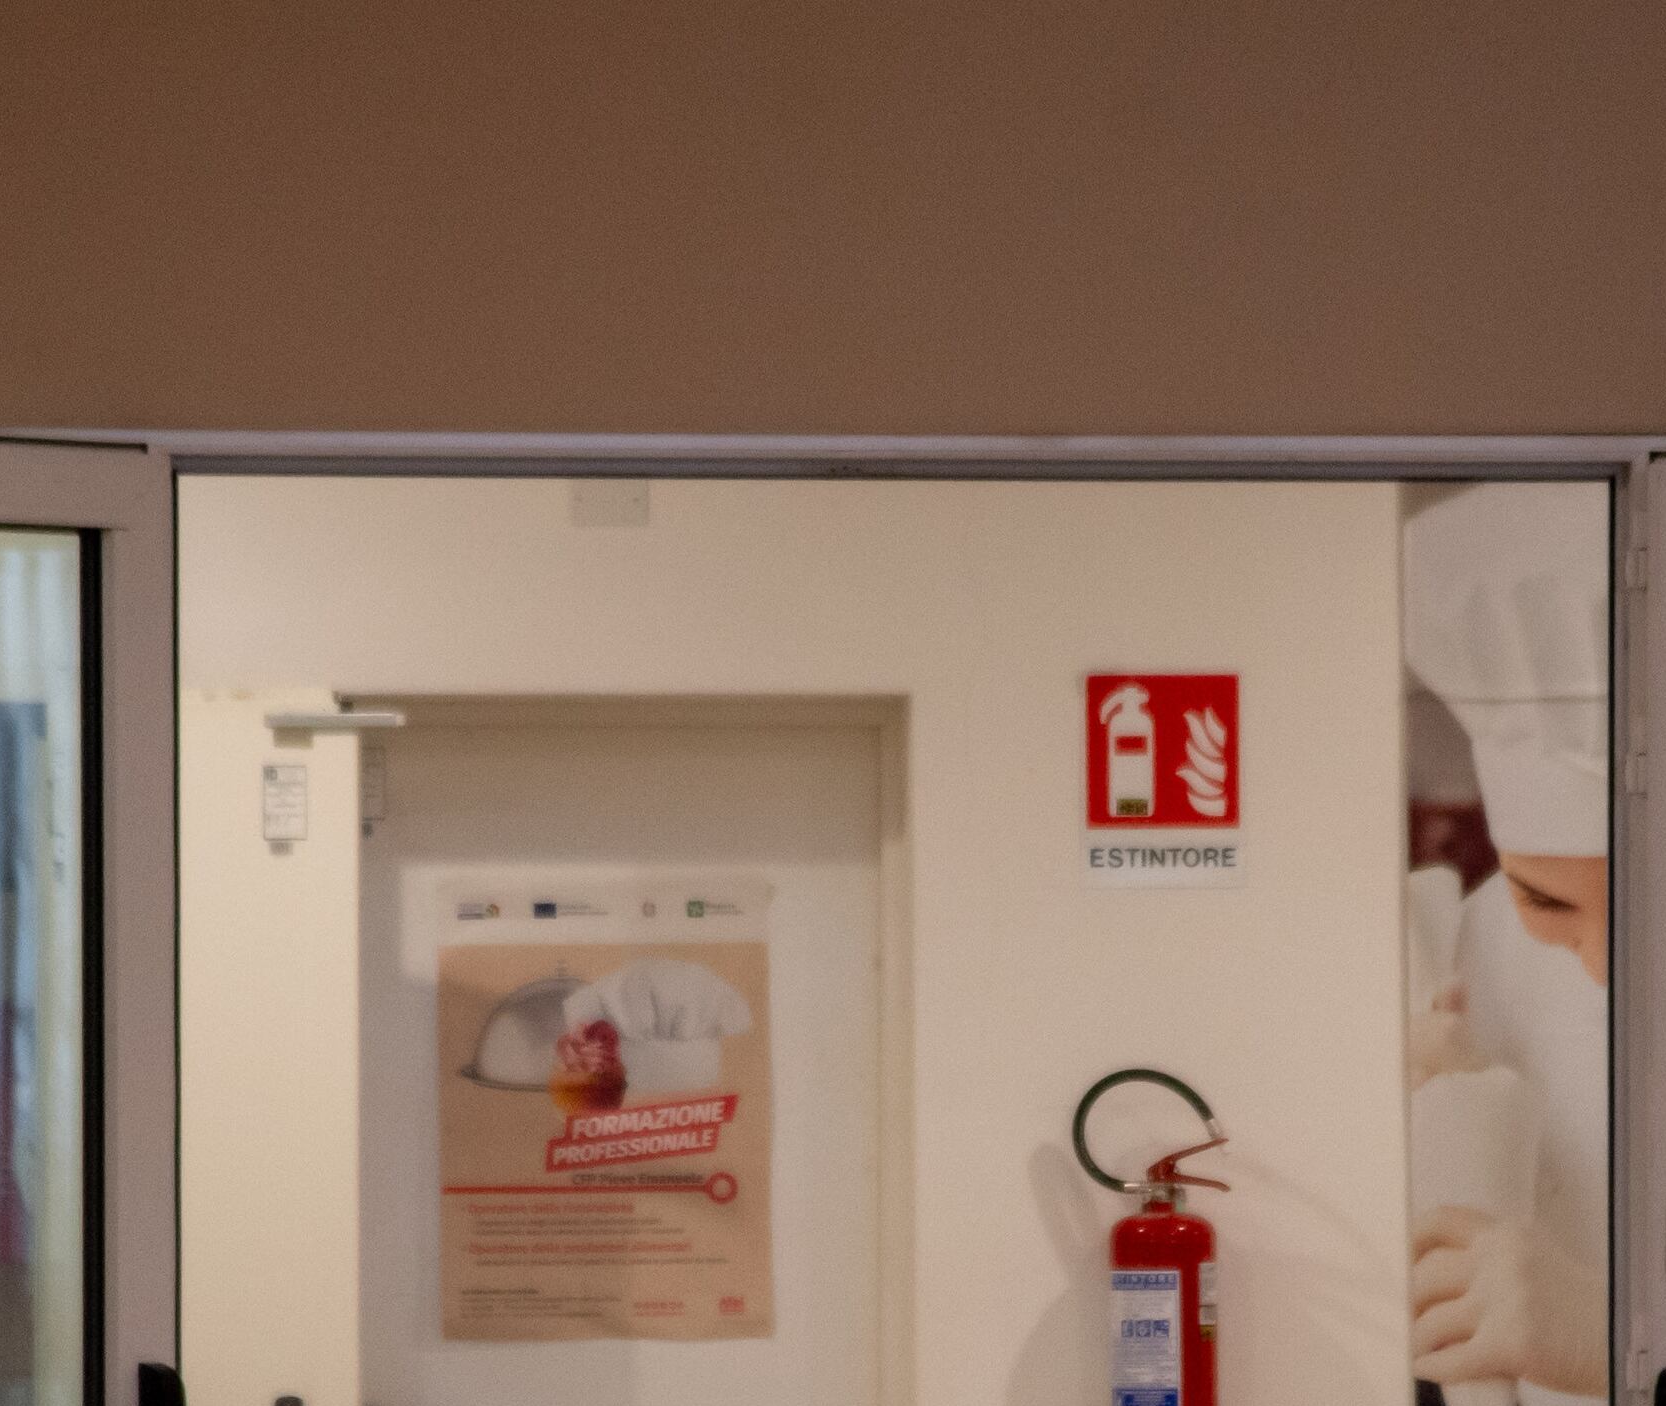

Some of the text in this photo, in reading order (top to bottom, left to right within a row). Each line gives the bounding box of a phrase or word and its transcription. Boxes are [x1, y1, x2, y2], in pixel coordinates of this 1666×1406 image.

[1089, 847, 1237, 868] ESTINTORE
[571, 1100, 726, 1140] FORMAZIONE
[552, 1128, 715, 1165] PROFESSIONALE
